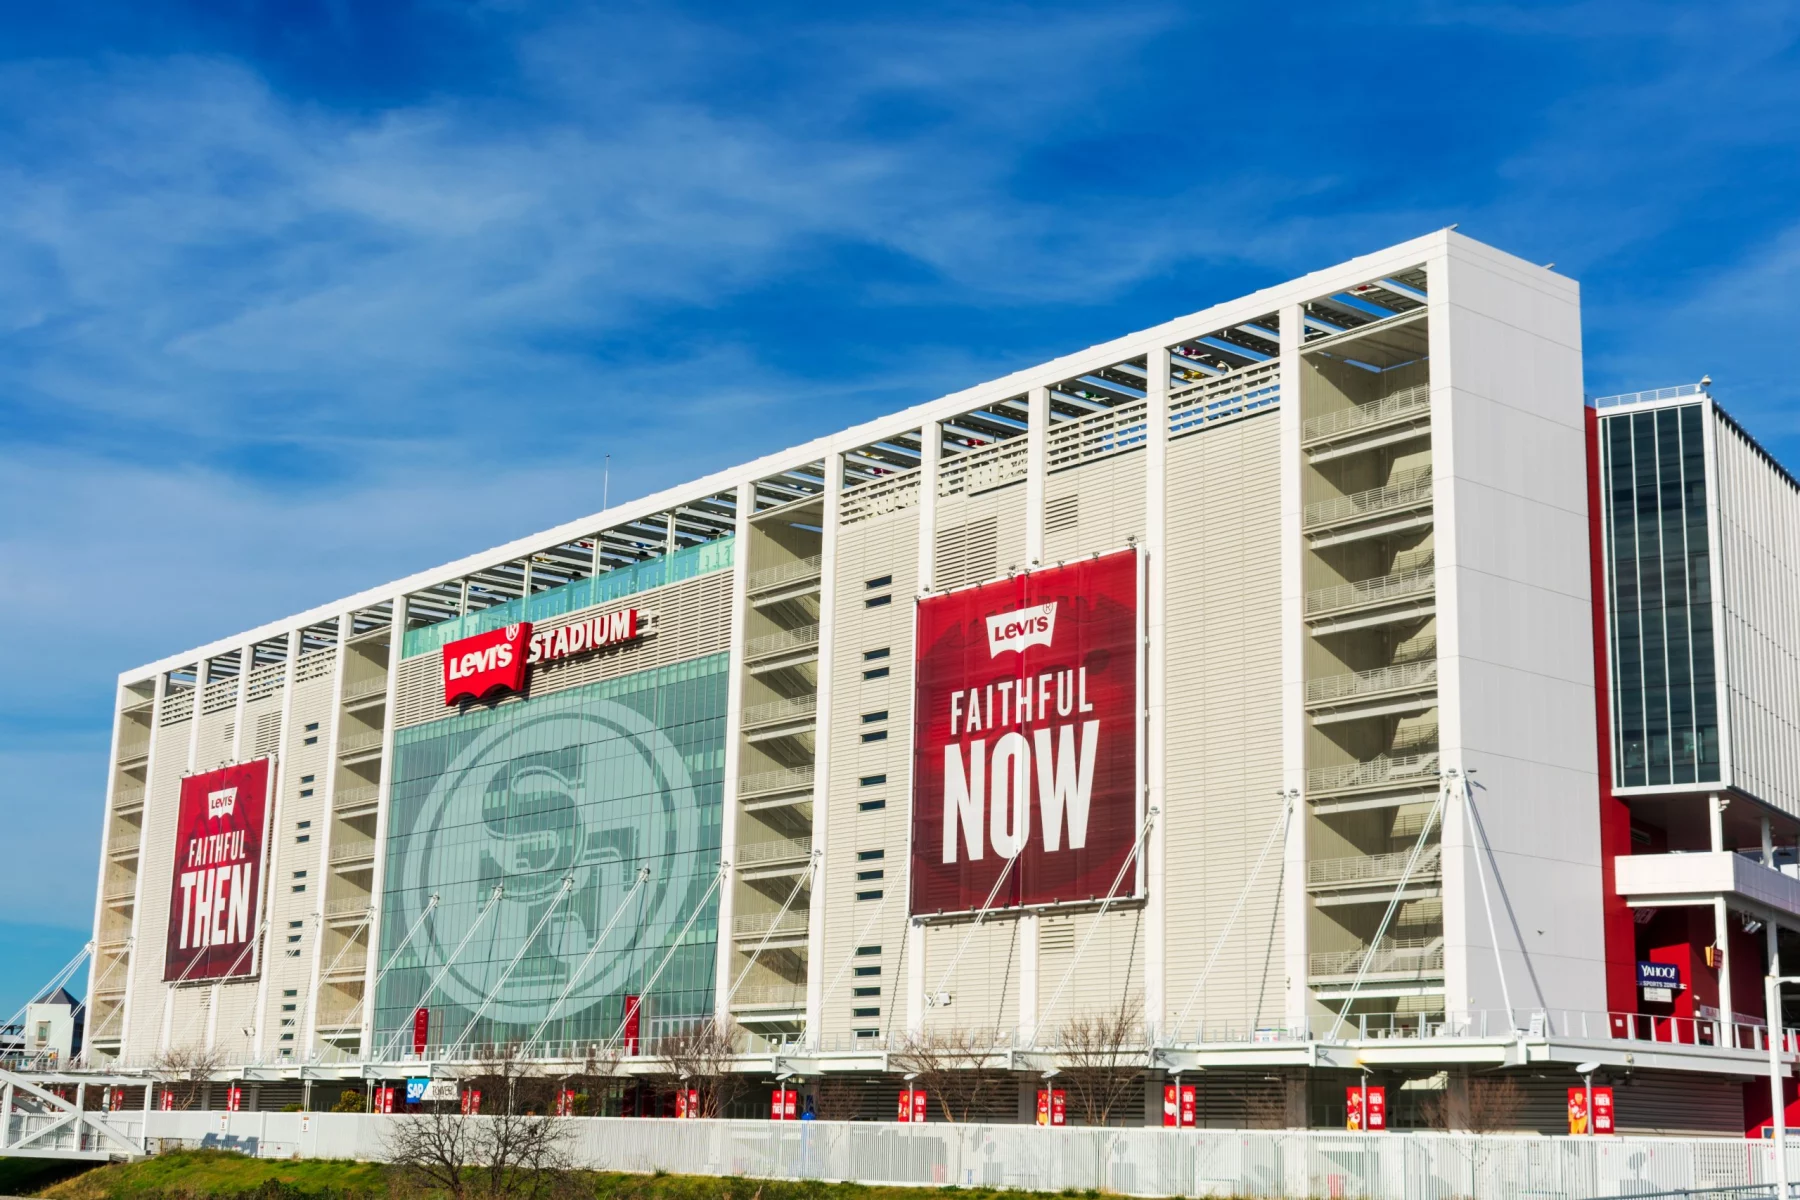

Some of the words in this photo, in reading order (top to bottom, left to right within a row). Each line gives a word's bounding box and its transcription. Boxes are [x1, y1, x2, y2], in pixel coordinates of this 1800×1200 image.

[526, 609, 632, 664] STADIUM
[950, 666, 1094, 736] FAITHFUL
[942, 719, 1101, 864] NOW
[187, 830, 246, 868] FAITHFUL
[179, 862, 252, 950] THEN
[1641, 964, 1676, 979] YAHOO!
[1643, 980, 1663, 988] SPORTS
[407, 1083, 424, 1099] SAP
